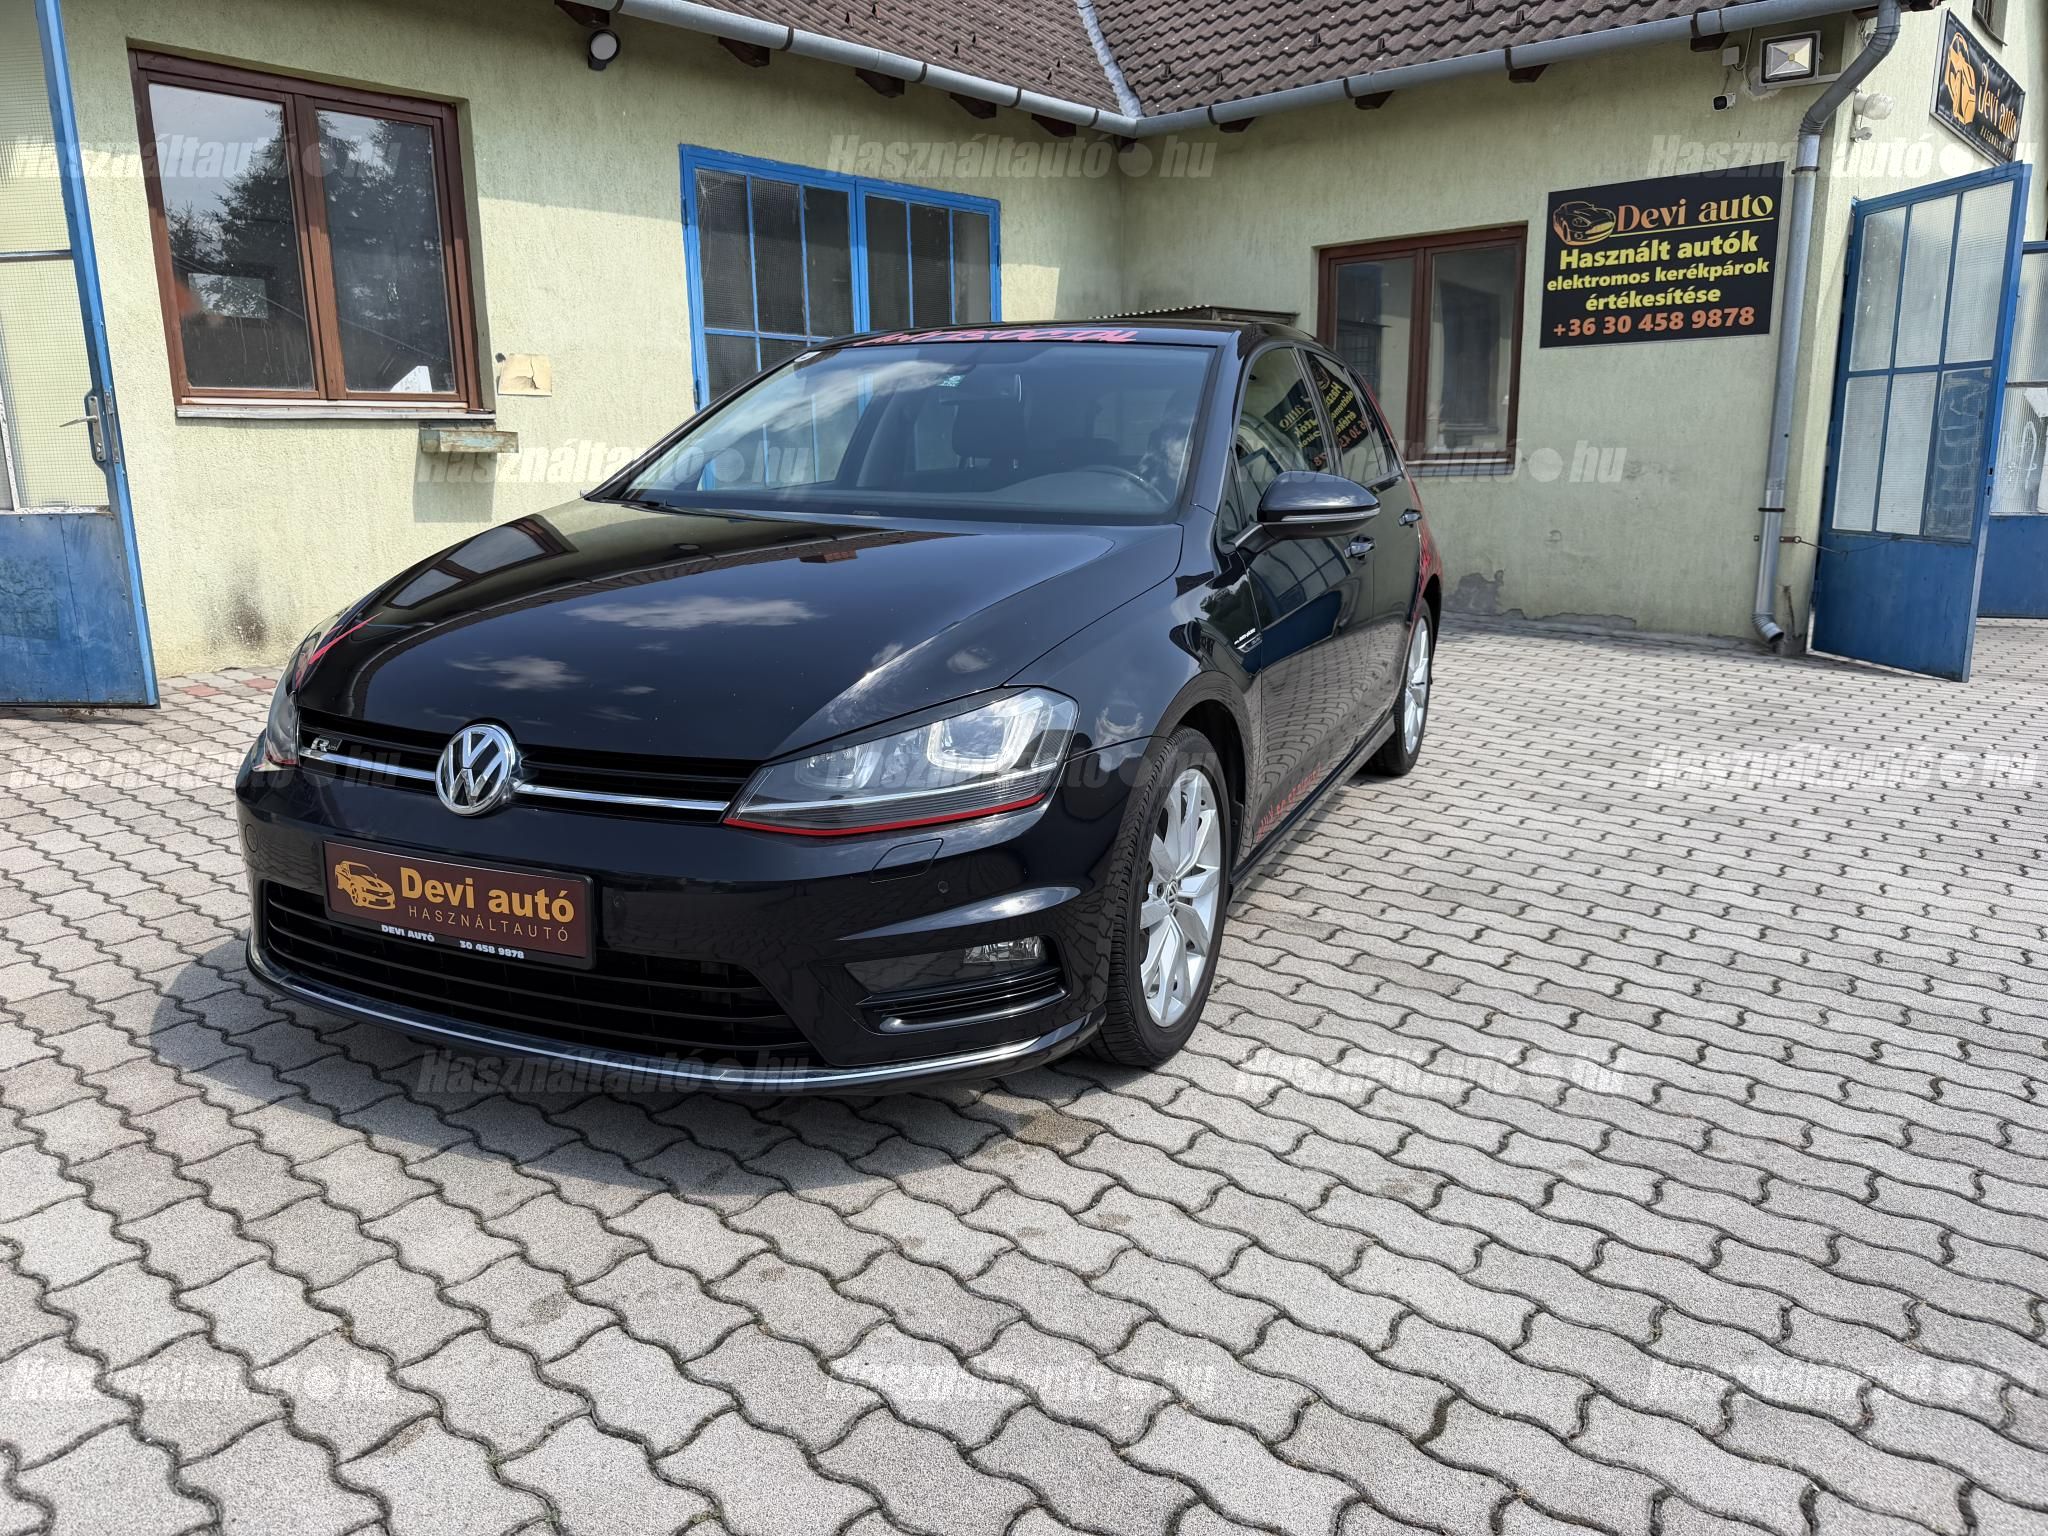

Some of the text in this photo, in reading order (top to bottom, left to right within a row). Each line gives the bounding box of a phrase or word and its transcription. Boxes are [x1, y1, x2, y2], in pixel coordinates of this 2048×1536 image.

[1617, 194, 1774, 232] Devi auto
[1559, 230, 1760, 270] Használt autók
[1547, 257, 1770, 291] elektromos kerékpárok
[1585, 286, 1721, 312] értékesítése
[1553, 306, 1755, 337] +36 30 458 9878
[400, 866, 575, 923] Devi autó
[381, 924, 525, 959] DEVI AUTÓ 30 458 9878
[408, 905, 569, 942] HASZNÁLTAUTÓ
